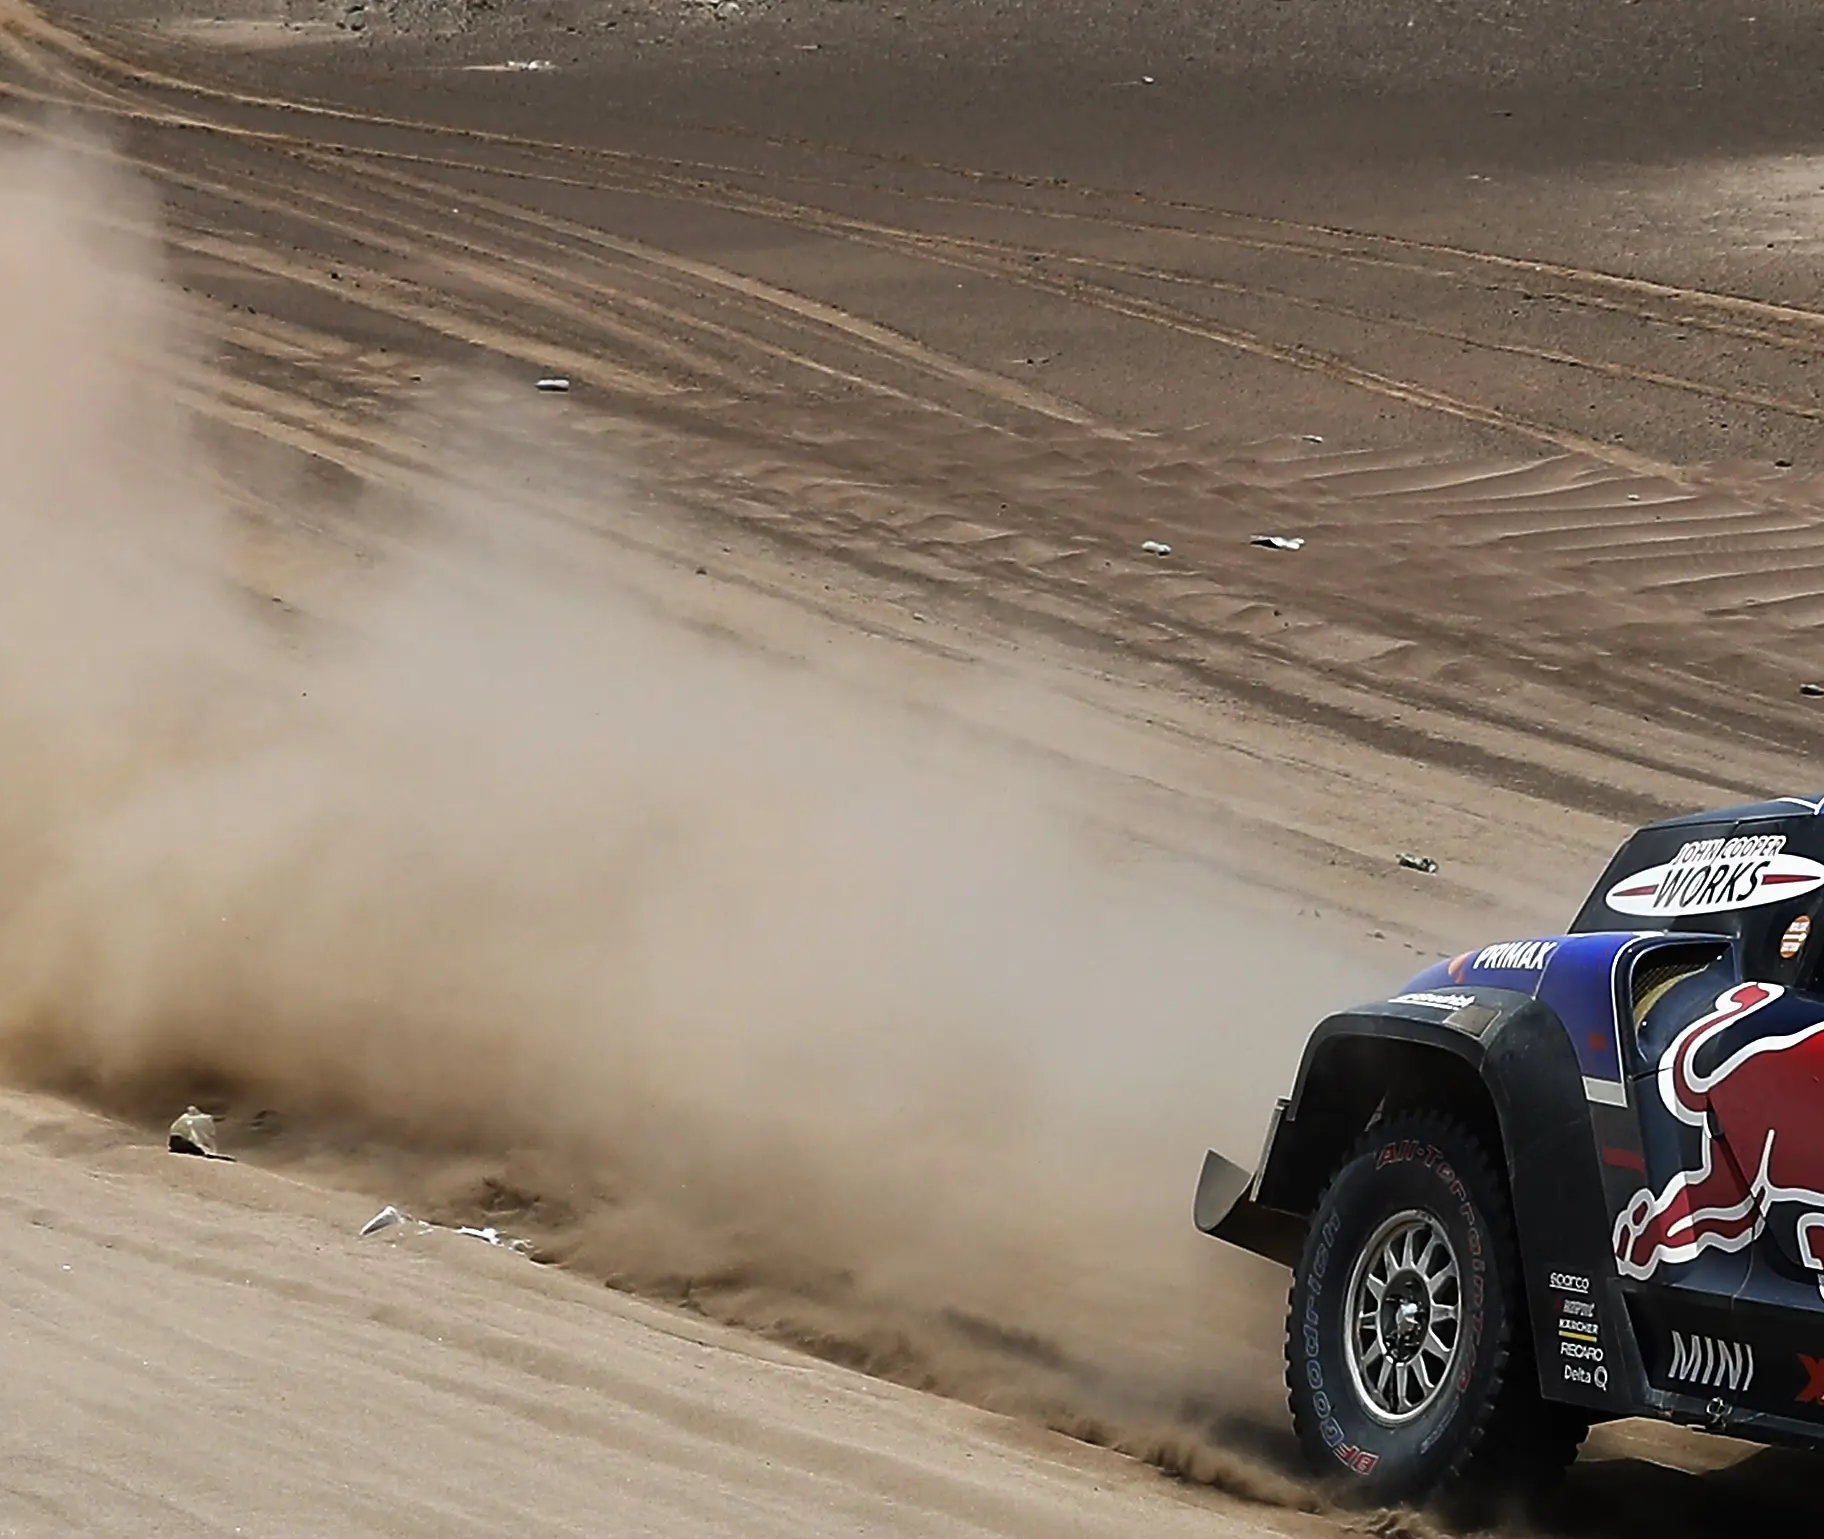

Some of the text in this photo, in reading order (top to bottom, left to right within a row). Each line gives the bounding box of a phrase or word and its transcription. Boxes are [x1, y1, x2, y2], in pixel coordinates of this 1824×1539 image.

[1673, 838, 1784, 866] JOHN COOPER
[1653, 860, 1771, 908] WORKS
[1473, 942, 1558, 969] PRIMAX
[1376, 1137, 1487, 1306] All-Terrain
[1303, 1211, 1380, 1475] BFGoodrich
[1560, 1342, 1604, 1361] RECARO
[1668, 1330, 1755, 1391] MINI
